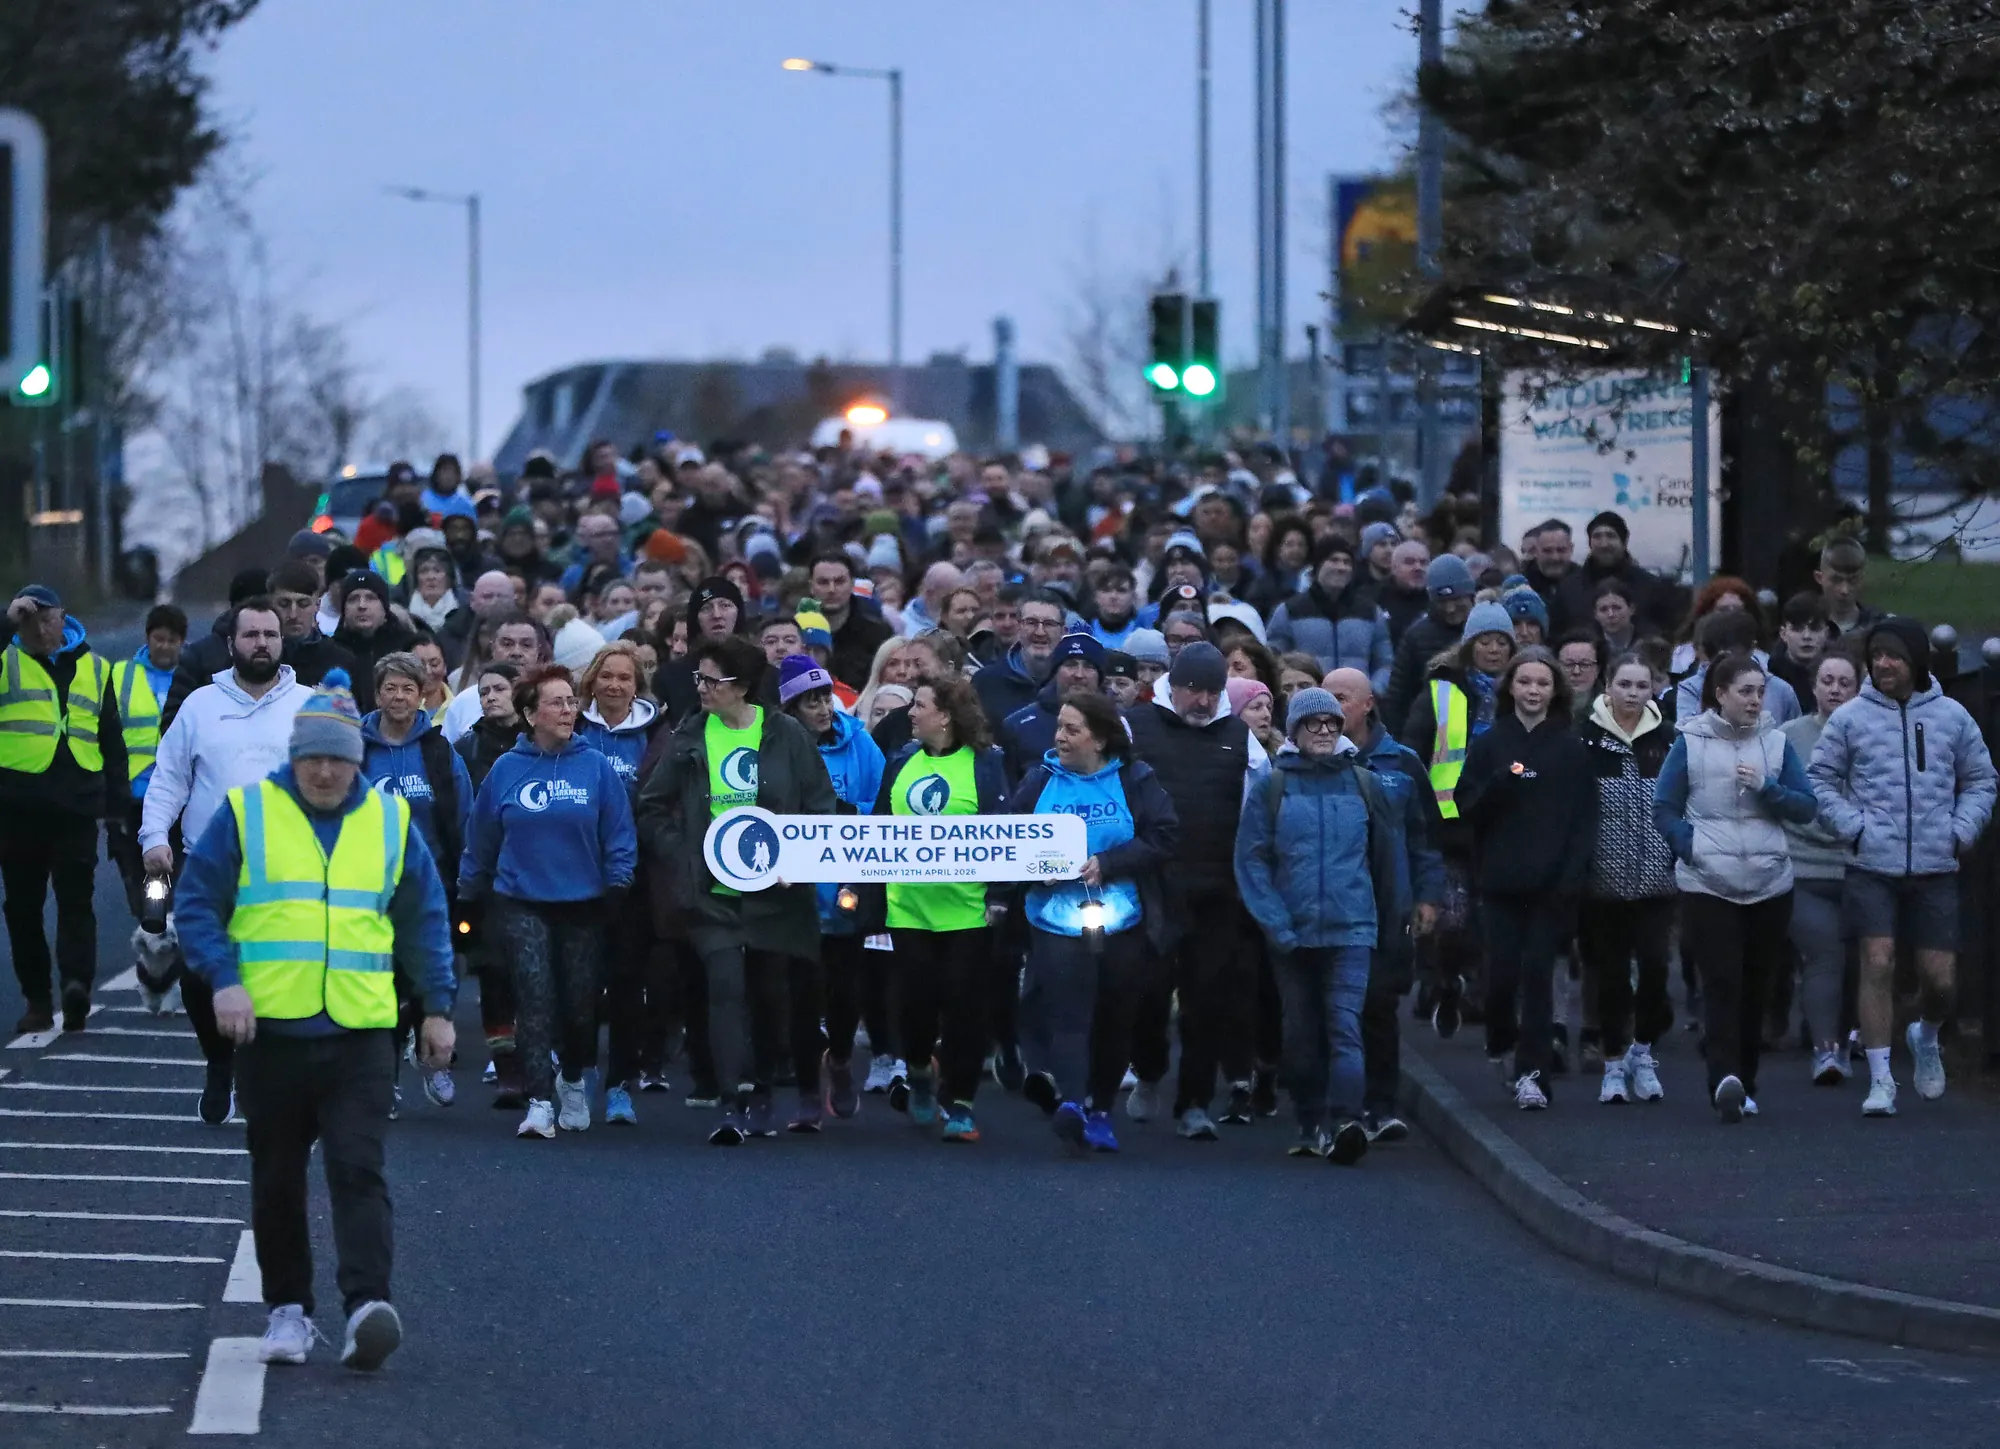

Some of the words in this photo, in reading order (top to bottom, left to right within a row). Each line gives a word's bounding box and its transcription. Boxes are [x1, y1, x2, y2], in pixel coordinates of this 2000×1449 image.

[547, 780, 566, 790] OUT
[1091, 801, 1118, 818] 50
[782, 824, 833, 841] OUT
[840, 824, 870, 841] OF
[877, 824, 923, 841] THE
[930, 823, 1054, 841] DARKNESS
[819, 847, 836, 863] A
[843, 847, 909, 863] WALK
[916, 846, 946, 863] OF
[954, 846, 1017, 862] HOPE
[954, 868, 977, 876] 2026
[1039, 866, 1070, 874] DISPLAY
